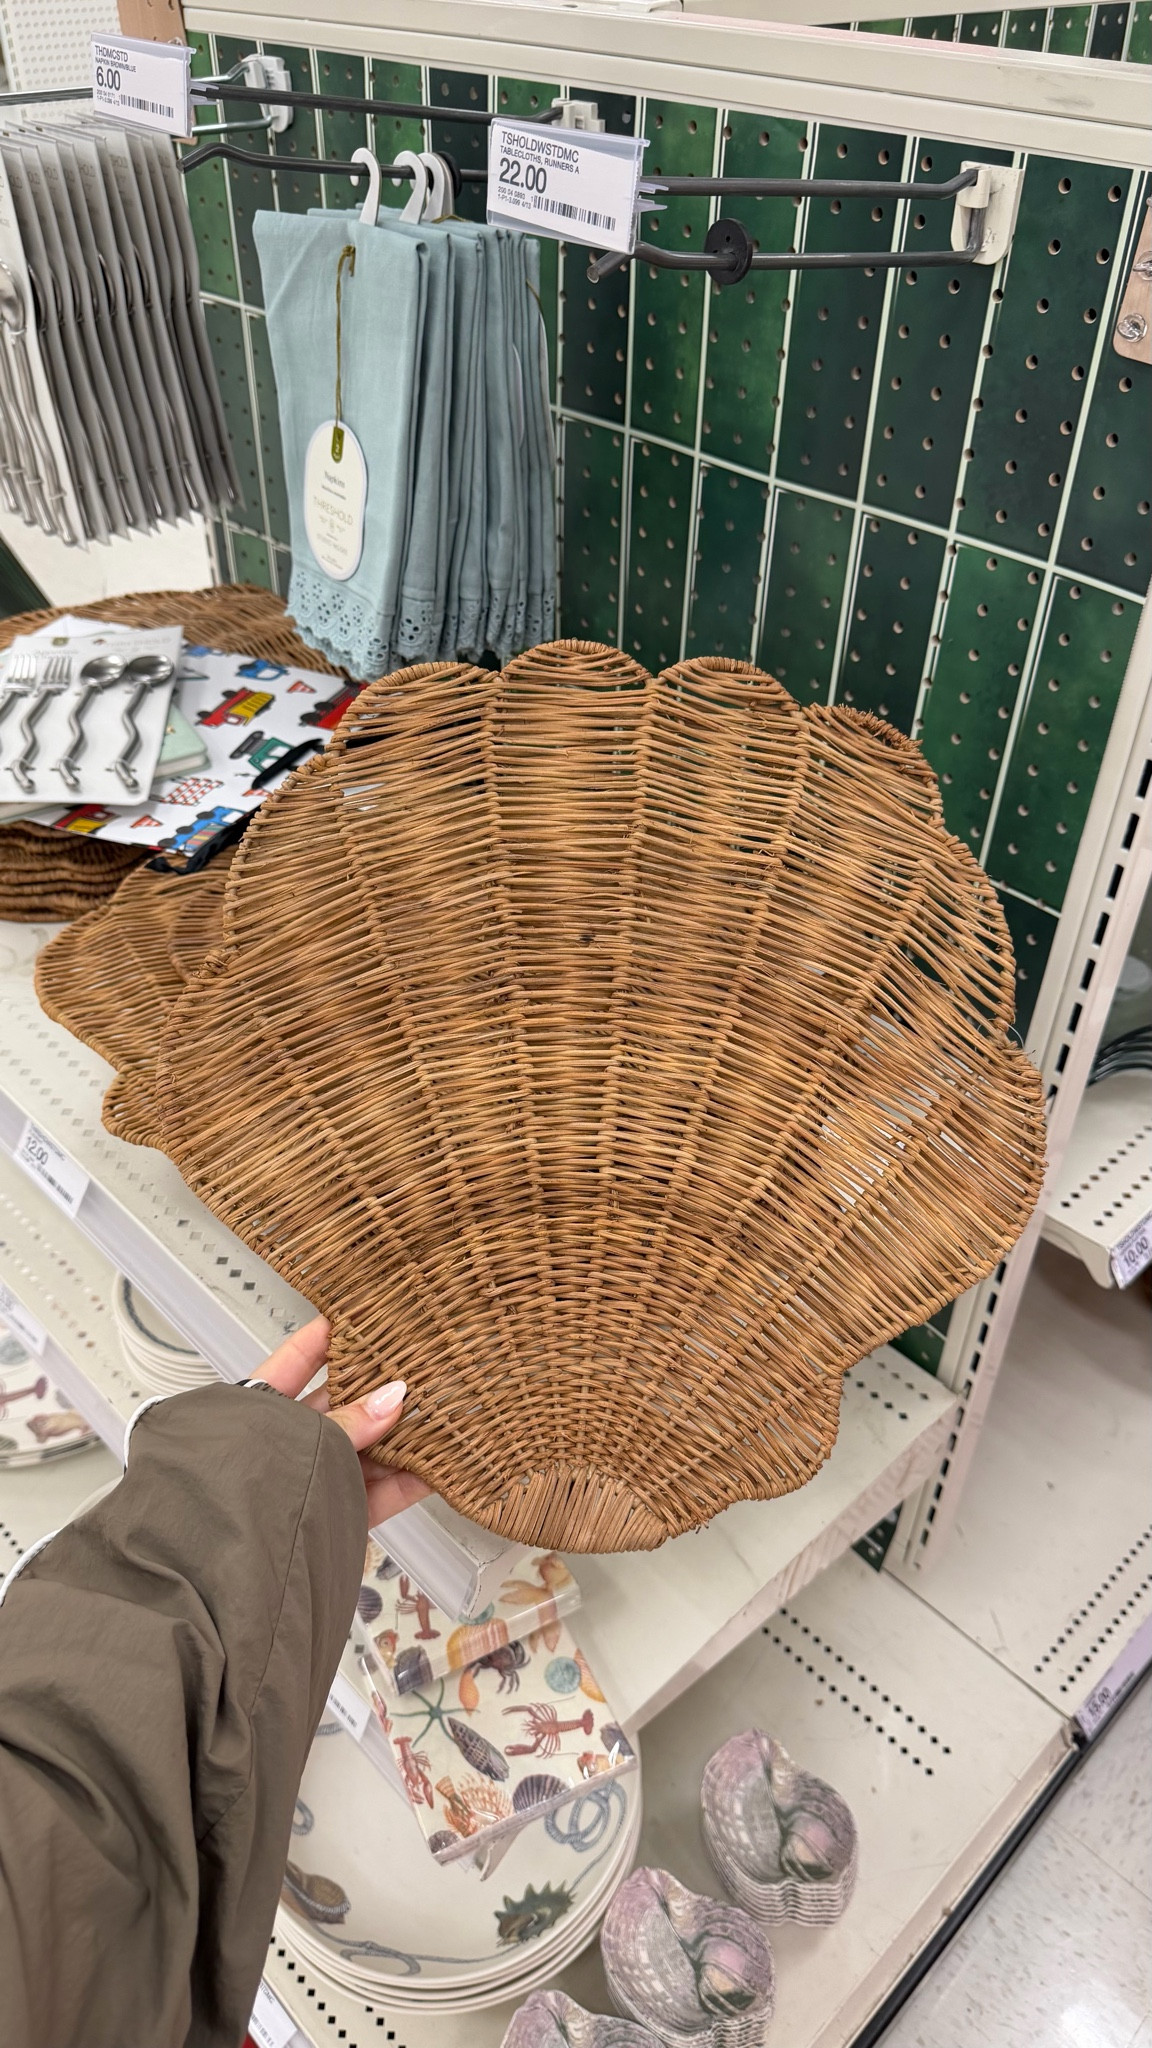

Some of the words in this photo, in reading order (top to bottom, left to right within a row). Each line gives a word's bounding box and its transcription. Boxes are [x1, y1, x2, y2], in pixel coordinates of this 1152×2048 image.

[95, 45, 128, 62] THDMCSTD
[96, 66, 121, 91] 6.00
[500, 145, 543, 166] TABLECLOTHS,
[544, 157, 574, 173] RUNNERS
[574, 166, 580, 174] A
[501, 130, 580, 164] TSHOLDWSTDMC
[499, 157, 547, 194] 22.00
[1124, 1236, 1148, 1267] 10.00
